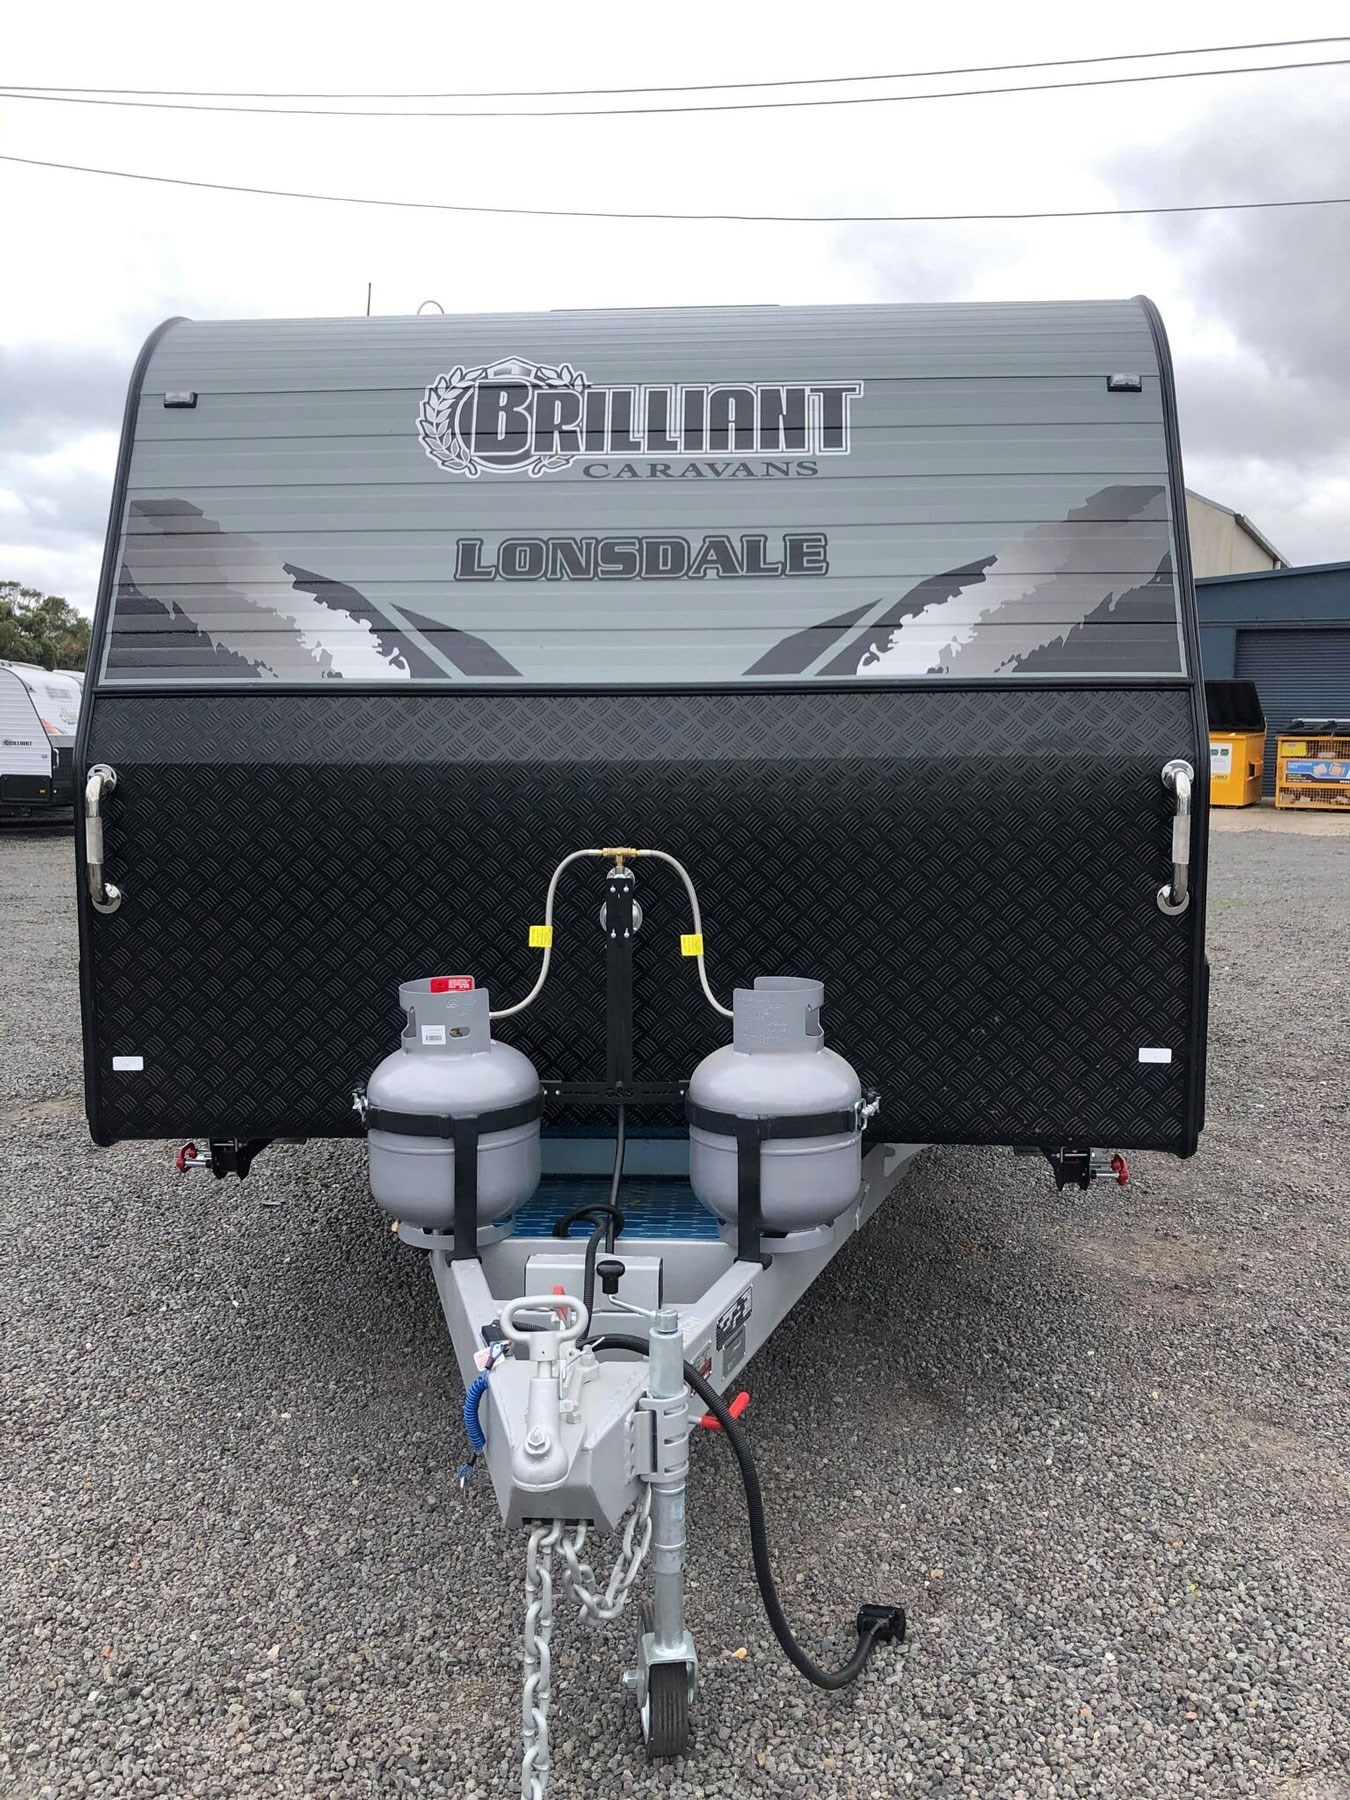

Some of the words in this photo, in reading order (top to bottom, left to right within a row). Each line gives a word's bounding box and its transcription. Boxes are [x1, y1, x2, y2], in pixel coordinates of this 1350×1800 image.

[470, 378, 864, 457] BRILLIANT
[583, 461, 819, 479] CARAVANS
[454, 533, 828, 581] LONSDALE
